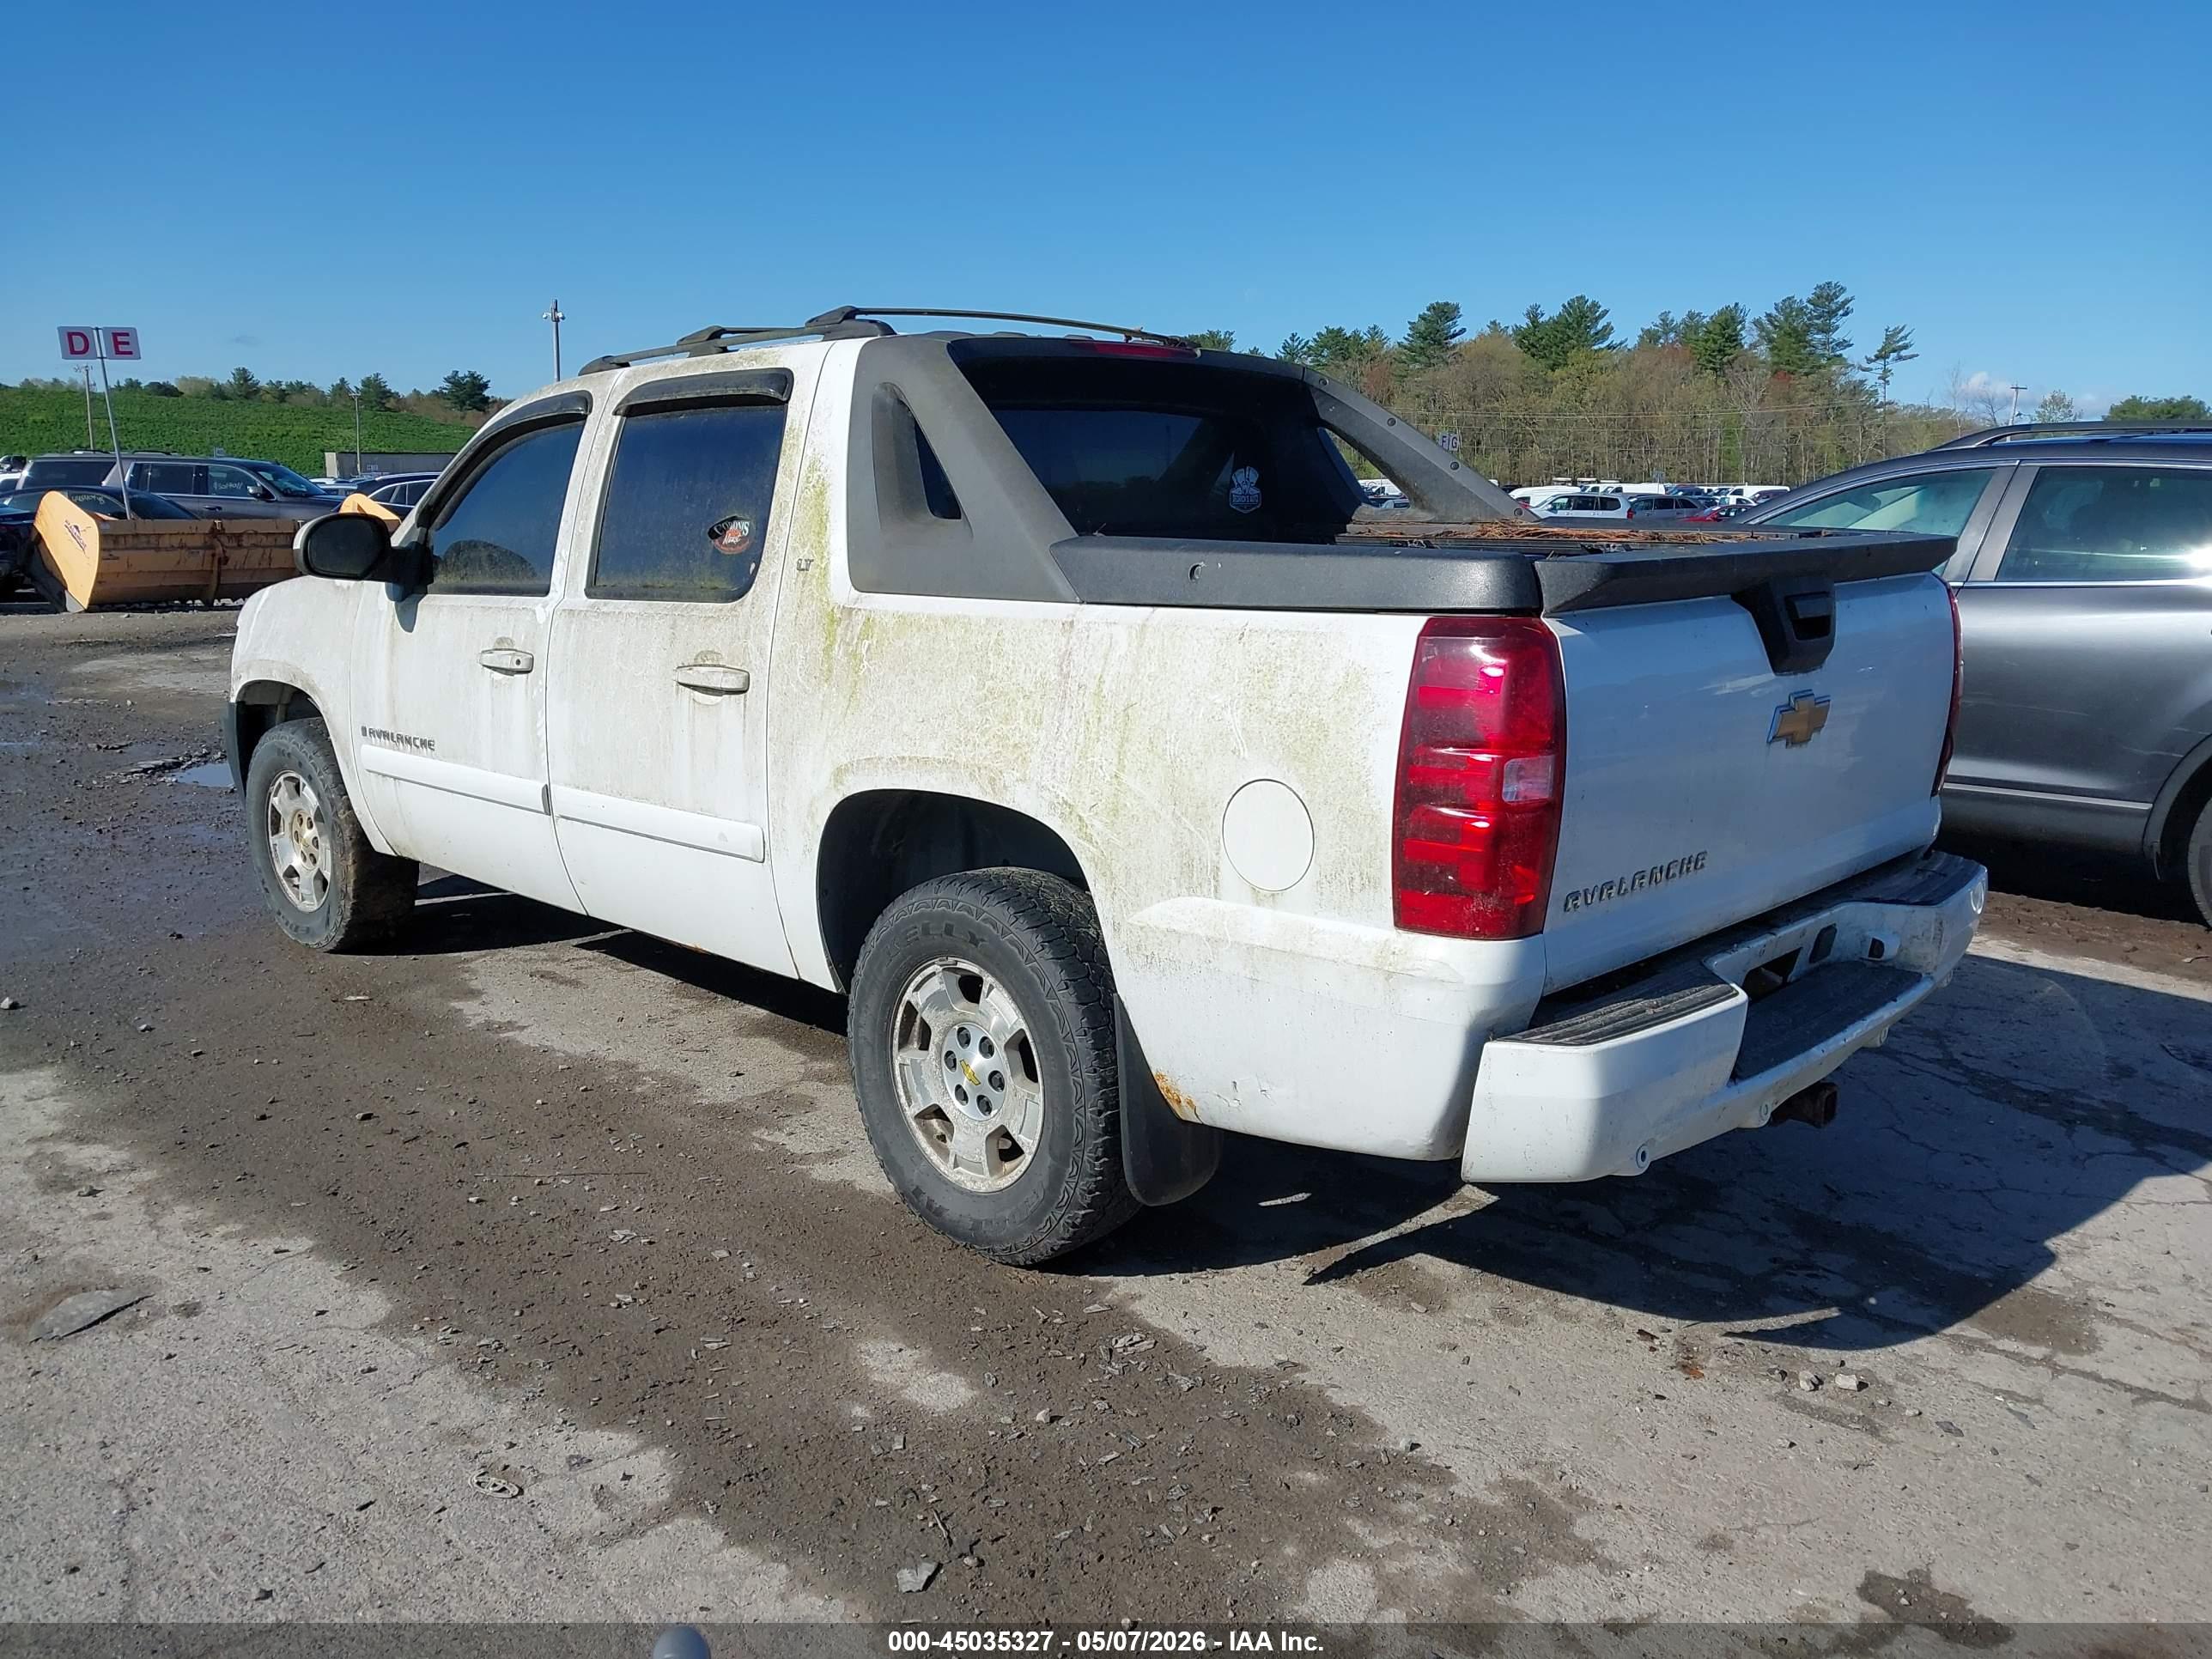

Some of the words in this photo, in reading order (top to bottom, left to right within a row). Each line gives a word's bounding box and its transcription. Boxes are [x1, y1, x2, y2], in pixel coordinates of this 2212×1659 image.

[67, 331, 89, 355] D
[112, 332, 133, 355] E
[1442, 435, 1447, 447] F
[1451, 436, 1458, 448] G
[796, 558, 814, 571] LT
[368, 727, 435, 751] AVALANCHE
[1564, 850, 1708, 912] AVALANCHE
